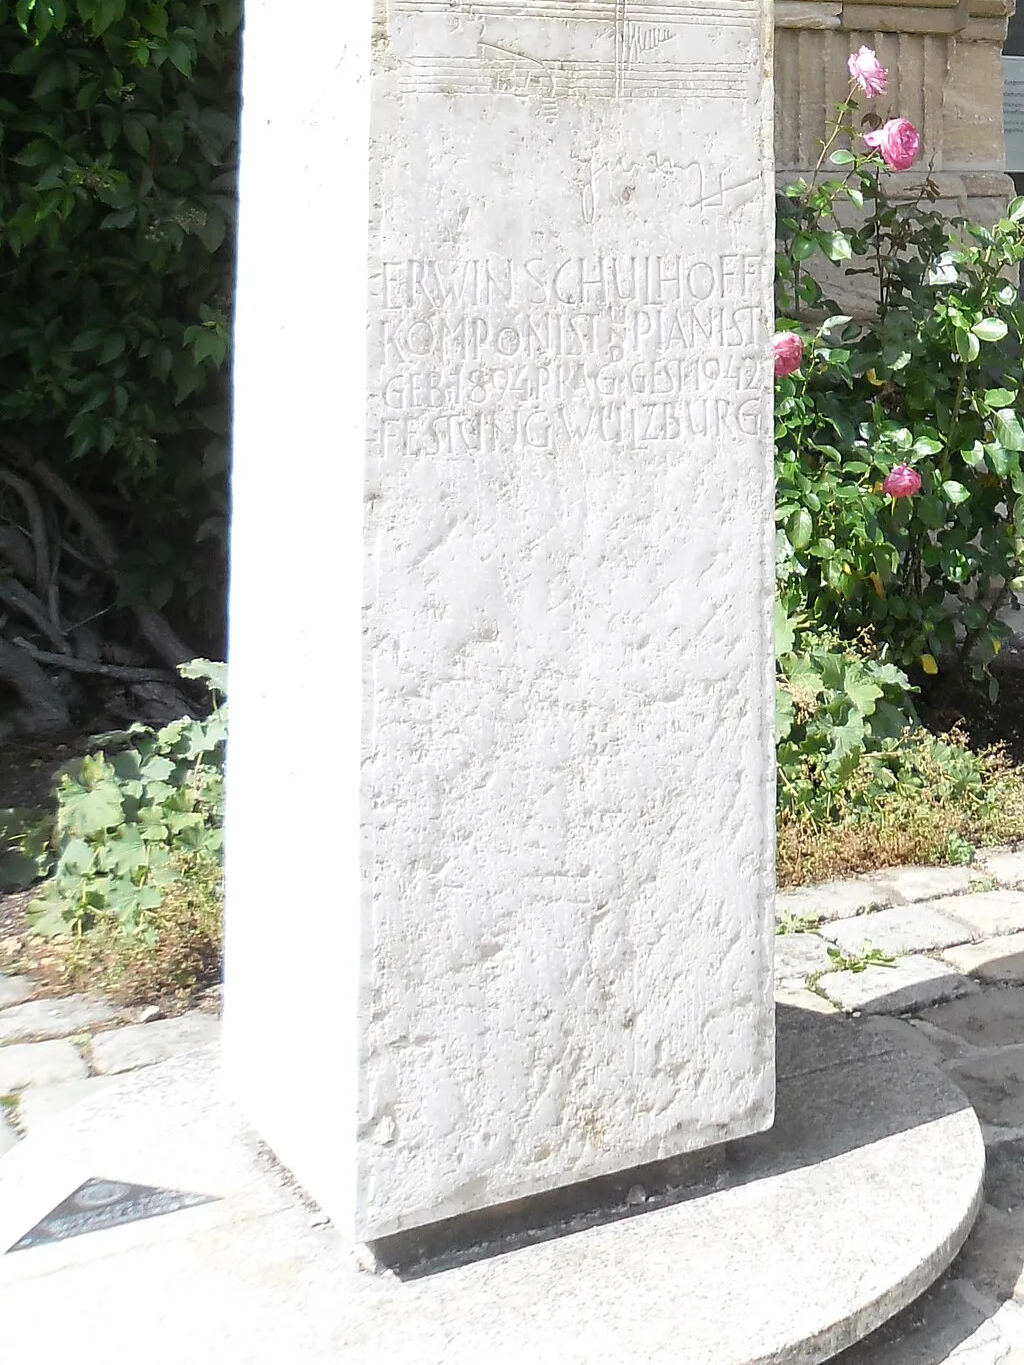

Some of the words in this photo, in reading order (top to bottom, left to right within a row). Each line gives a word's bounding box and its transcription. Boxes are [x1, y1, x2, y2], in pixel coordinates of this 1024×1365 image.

[382, 258, 513, 309] ERWIN
[524, 253, 762, 306] SCHULHOFF
[380, 312, 600, 364] KOMPONIST
[633, 305, 763, 352] PIANIST
[534, 362, 618, 400] PRAG
[686, 353, 761, 391] 1942
[380, 409, 551, 458] FESTUNG
